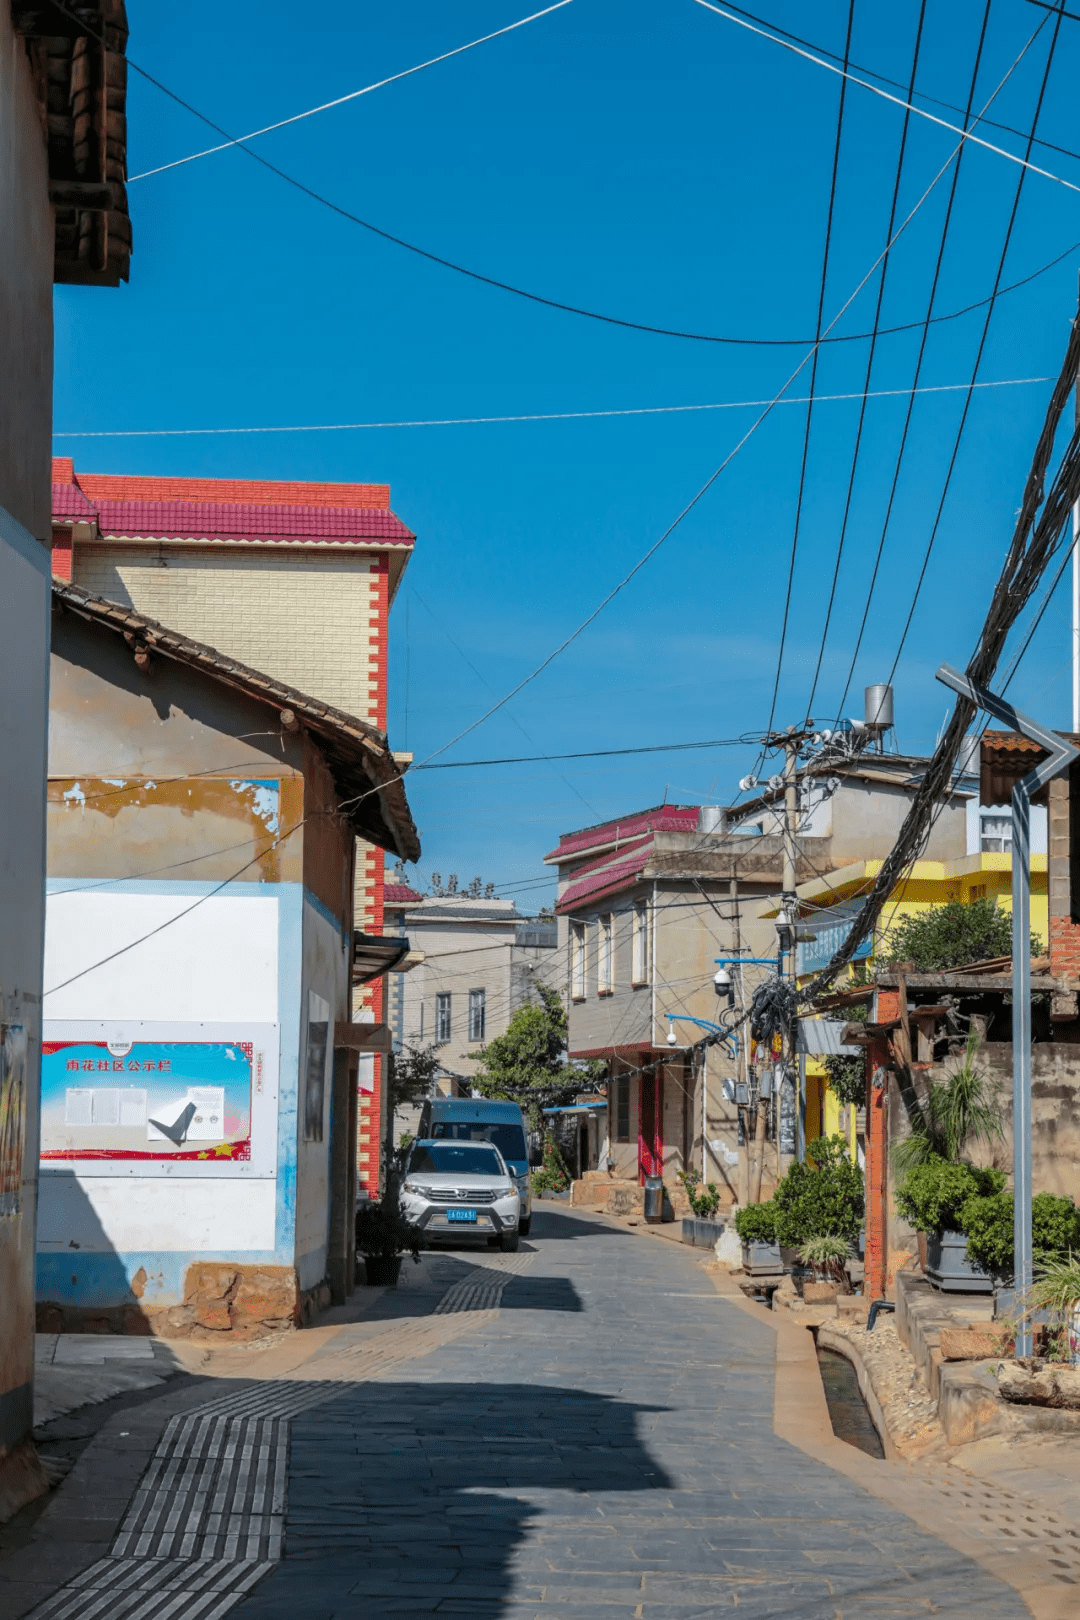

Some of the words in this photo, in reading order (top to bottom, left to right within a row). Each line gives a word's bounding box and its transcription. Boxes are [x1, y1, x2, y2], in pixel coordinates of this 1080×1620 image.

[66, 1059, 172, 1072] 雨花社区公示栏
